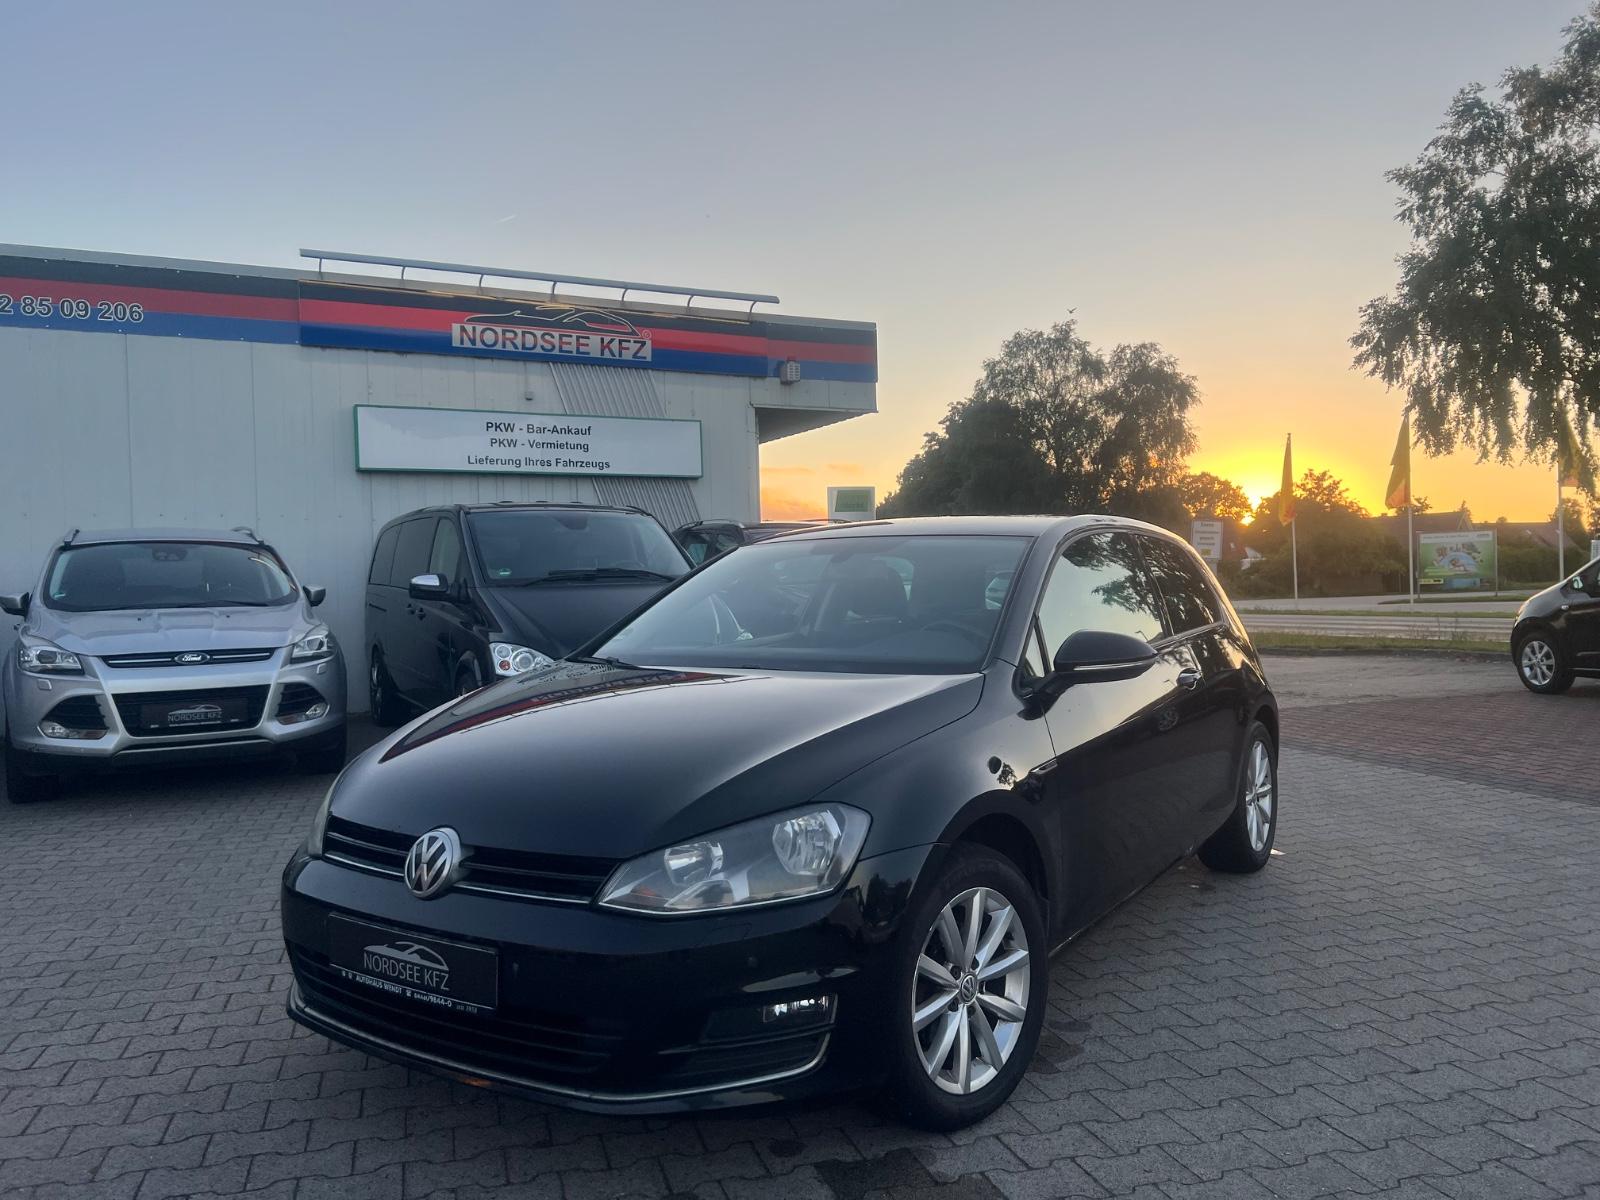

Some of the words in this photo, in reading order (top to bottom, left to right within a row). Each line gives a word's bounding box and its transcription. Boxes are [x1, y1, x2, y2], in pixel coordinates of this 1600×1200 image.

[0, 294, 13, 314] 2
[21, 296, 52, 317] 85
[60, 298, 90, 319] 09
[98, 301, 144, 323] 206
[459, 325, 591, 355] NORDSEE
[600, 337, 647, 360] KFZ
[485, 421, 516, 433] PKW
[526, 424, 592, 436] Bar-Ankauf
[490, 438, 518, 448] PKW
[528, 439, 589, 452] Vermietung
[467, 455, 522, 468] Lieferung
[524, 456, 552, 467] Ihres
[555, 457, 611, 470] Fahrzeugs
[167, 711, 207, 722] NORDSEE
[207, 711, 223, 720] KFZ
[363, 952, 421, 983] NORDSEE
[424, 968, 449, 991] KFZ
[355, 975, 383, 989] AUTOHAUS
